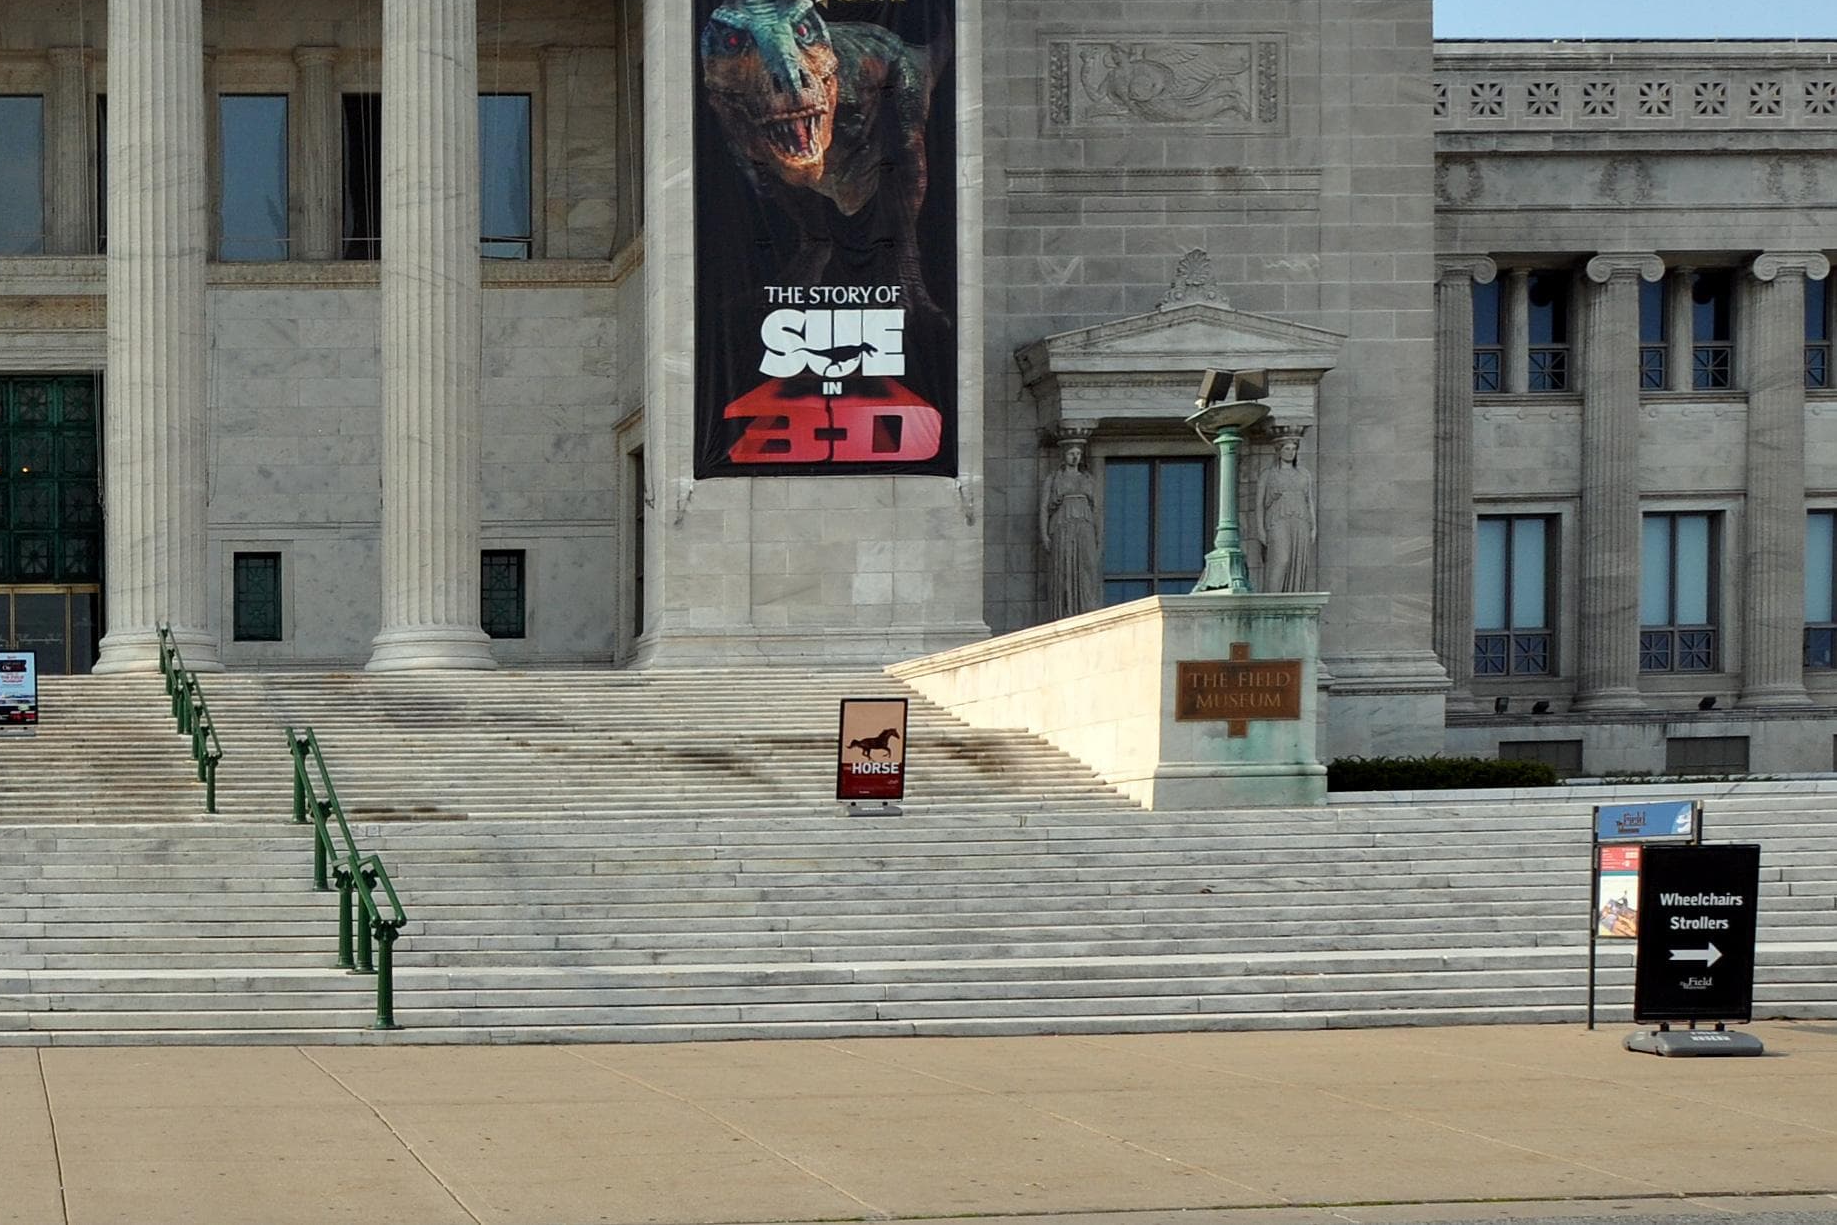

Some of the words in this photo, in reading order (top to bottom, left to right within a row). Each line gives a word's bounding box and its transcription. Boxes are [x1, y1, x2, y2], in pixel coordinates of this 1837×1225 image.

[764, 286, 804, 304] THE
[809, 286, 871, 304] STORY
[875, 286, 902, 304] OF
[759, 308, 906, 378] SUE
[822, 381, 843, 395] IN
[1190, 672, 1228, 688] THE
[1238, 671, 1291, 687] FIELD
[1196, 693, 1282, 709] MUSEUM
[852, 762, 900, 774] HORSE
[1660, 892, 1743, 906] Wheelchairs
[1670, 916, 1729, 930] Strollers
